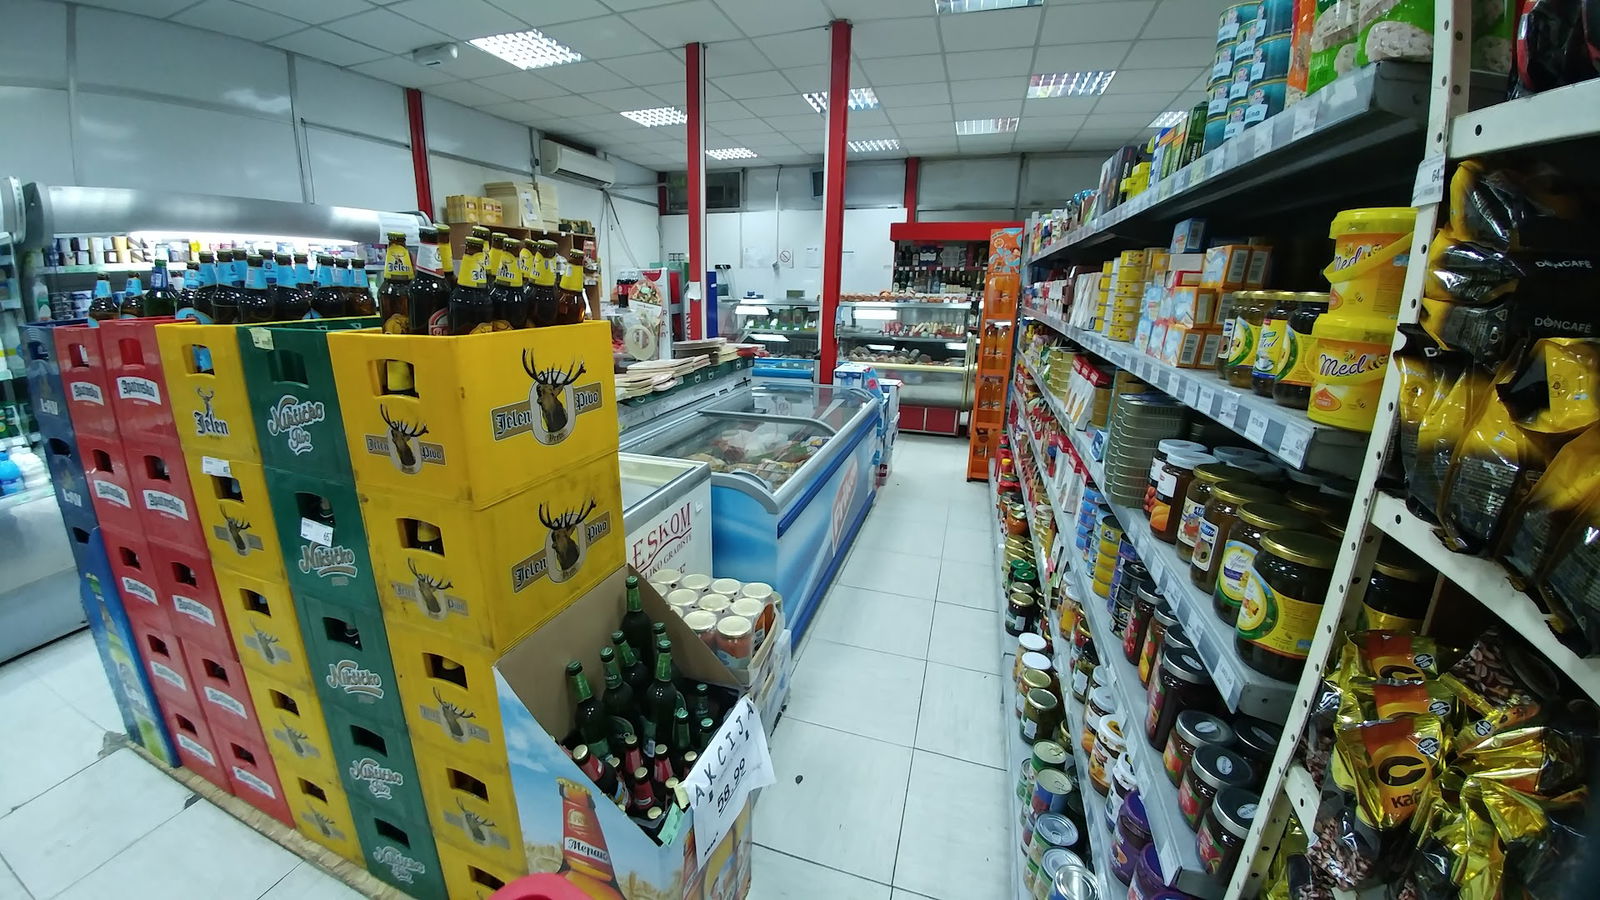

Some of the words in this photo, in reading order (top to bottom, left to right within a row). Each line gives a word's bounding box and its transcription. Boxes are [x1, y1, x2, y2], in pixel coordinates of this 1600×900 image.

[1320, 353, 1367, 378] Med
[194, 411, 229, 434] Jelen
[496, 409, 532, 435] Jelen
[575, 392, 599, 411] Pivo
[514, 558, 546, 589] Jelen
[587, 521, 607, 542] Pivo
[633, 502, 691, 570] ESKOM
[694, 702, 755, 807] AKCIJA
